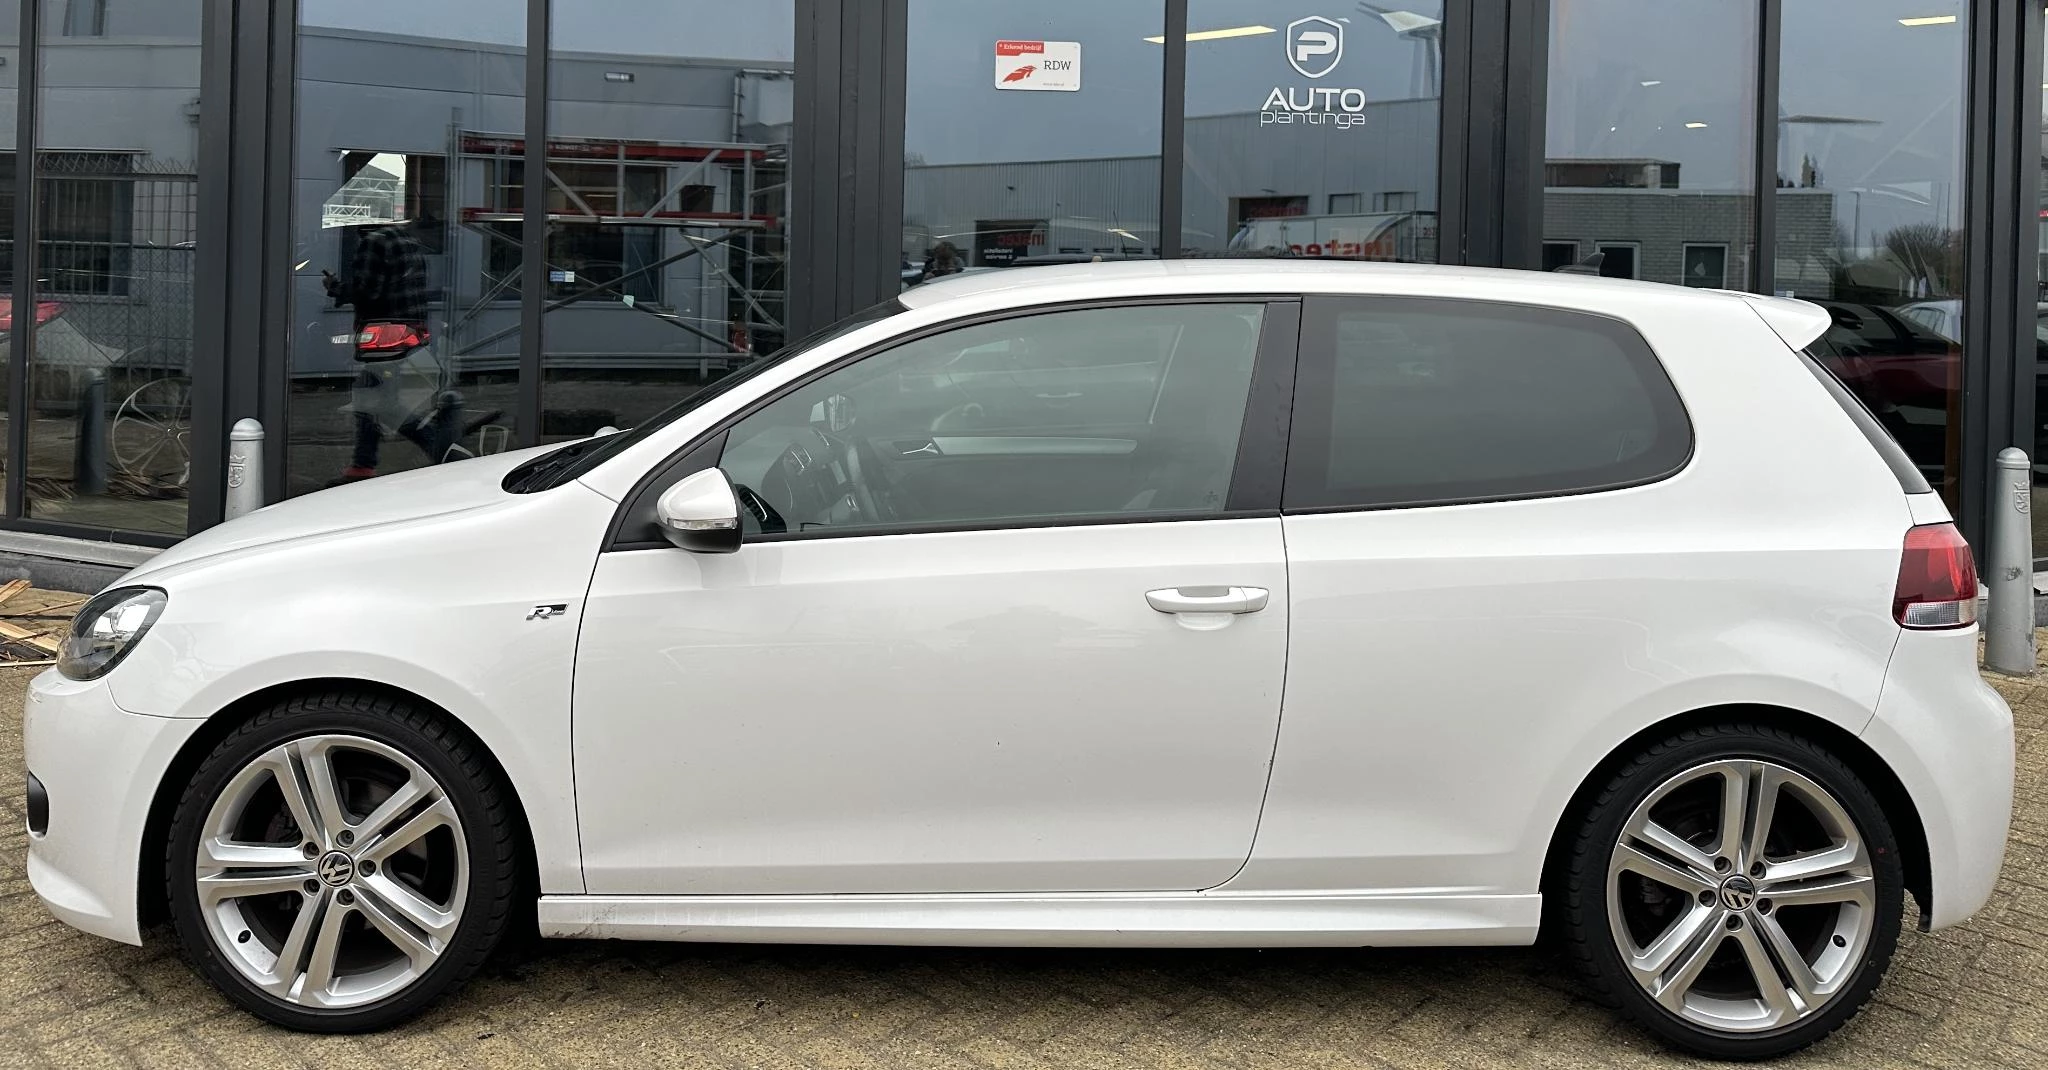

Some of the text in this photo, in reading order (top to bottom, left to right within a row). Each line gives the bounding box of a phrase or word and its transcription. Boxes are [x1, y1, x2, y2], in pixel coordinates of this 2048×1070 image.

[1297, 31, 1337, 61] P
[1044, 60, 1071, 71] RDW
[1261, 87, 1366, 112] AUTO
[1260, 109, 1366, 129] plantinga
